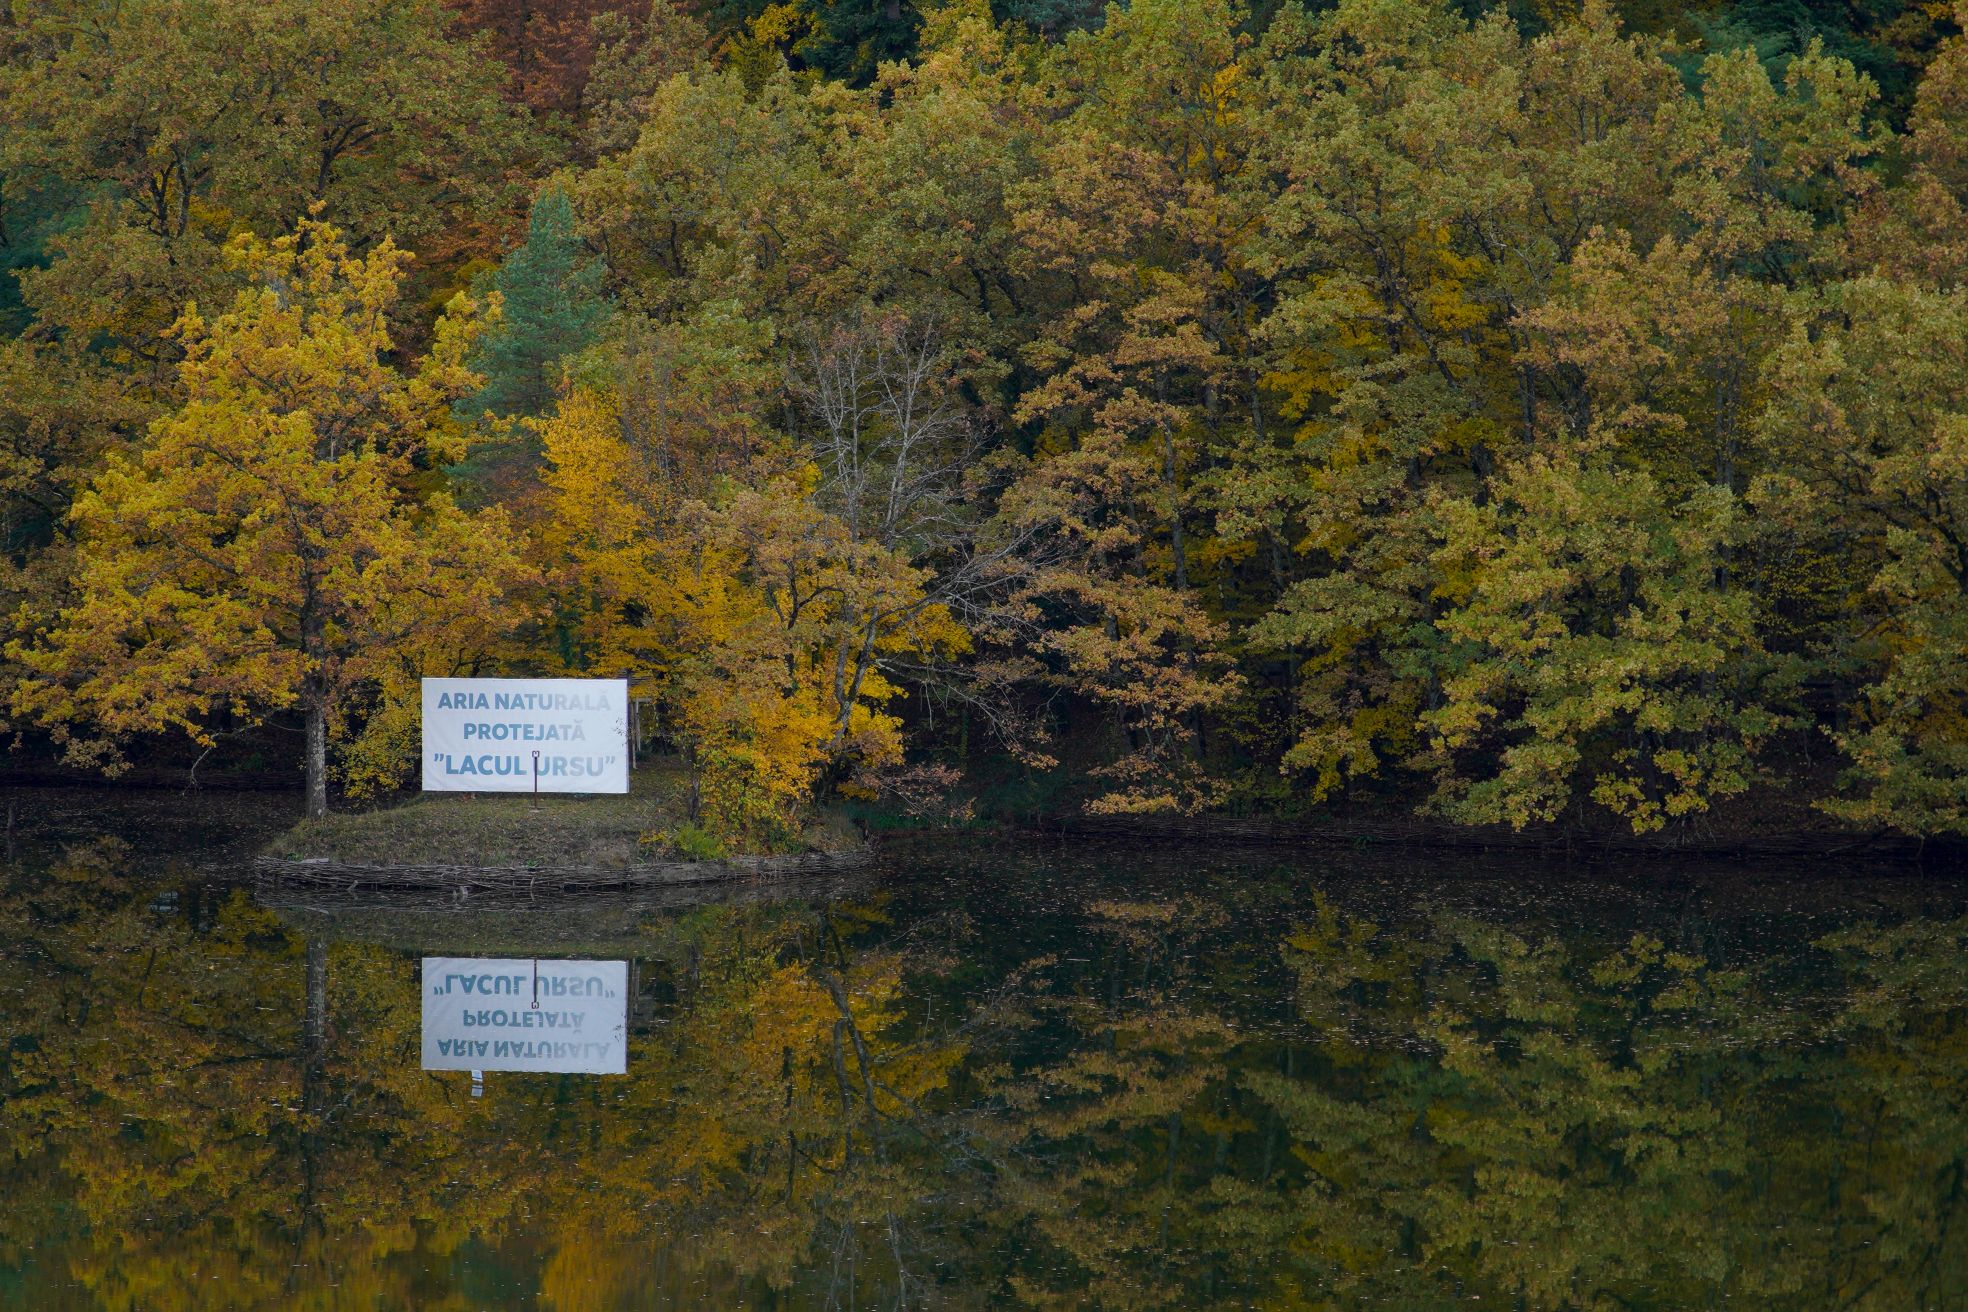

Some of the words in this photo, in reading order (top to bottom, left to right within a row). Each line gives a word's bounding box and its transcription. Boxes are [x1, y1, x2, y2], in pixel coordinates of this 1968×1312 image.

[437, 692, 490, 710] ARIA
[494, 690, 612, 711] NATURALĂ
[463, 719, 586, 741] PROTEJATĂ
